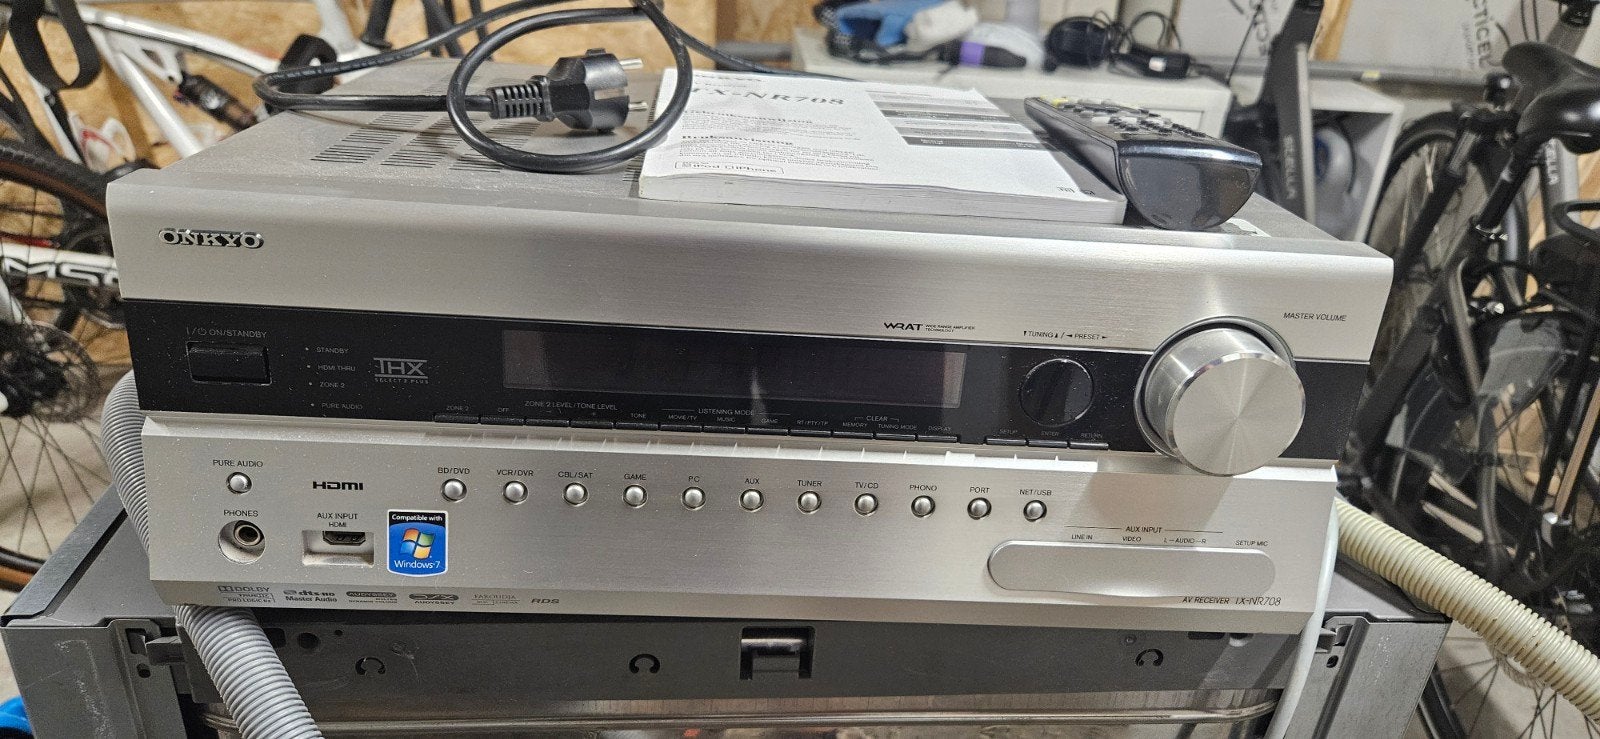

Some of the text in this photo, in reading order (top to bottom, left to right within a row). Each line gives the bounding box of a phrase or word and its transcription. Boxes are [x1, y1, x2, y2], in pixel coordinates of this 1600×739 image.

[159, 227, 264, 249] ONKYO
[1282, 312, 1347, 322] MASTER VOLUME
[883, 322, 923, 331] WRAT
[209, 328, 267, 338] ON/STANDBY
[1074, 332, 1100, 340] PRESET
[316, 346, 349, 354] STANDBY
[374, 357, 428, 379] THX
[212, 459, 264, 468] PURE AUDIO
[437, 466, 471, 475] BD/DVD
[496, 468, 534, 477] VCR/DVR
[557, 471, 593, 480] CBL/SAT
[623, 473, 647, 481] GAME
[688, 475, 700, 483] PC
[312, 480, 364, 491] HDMI
[744, 477, 760, 485] AUX
[909, 484, 937, 492] PHONO
[969, 486, 990, 494] PORT
[1019, 488, 1052, 497] NET/USB
[223, 509, 259, 517] PHONES
[316, 512, 358, 520] AUX INPUT
[391, 513, 443, 522] Compatible with
[1141, 526, 1162, 534] INPUT
[394, 559, 441, 569] Windows 7
[1182, 596, 1281, 606] AV RECEIVER TX-NR708
